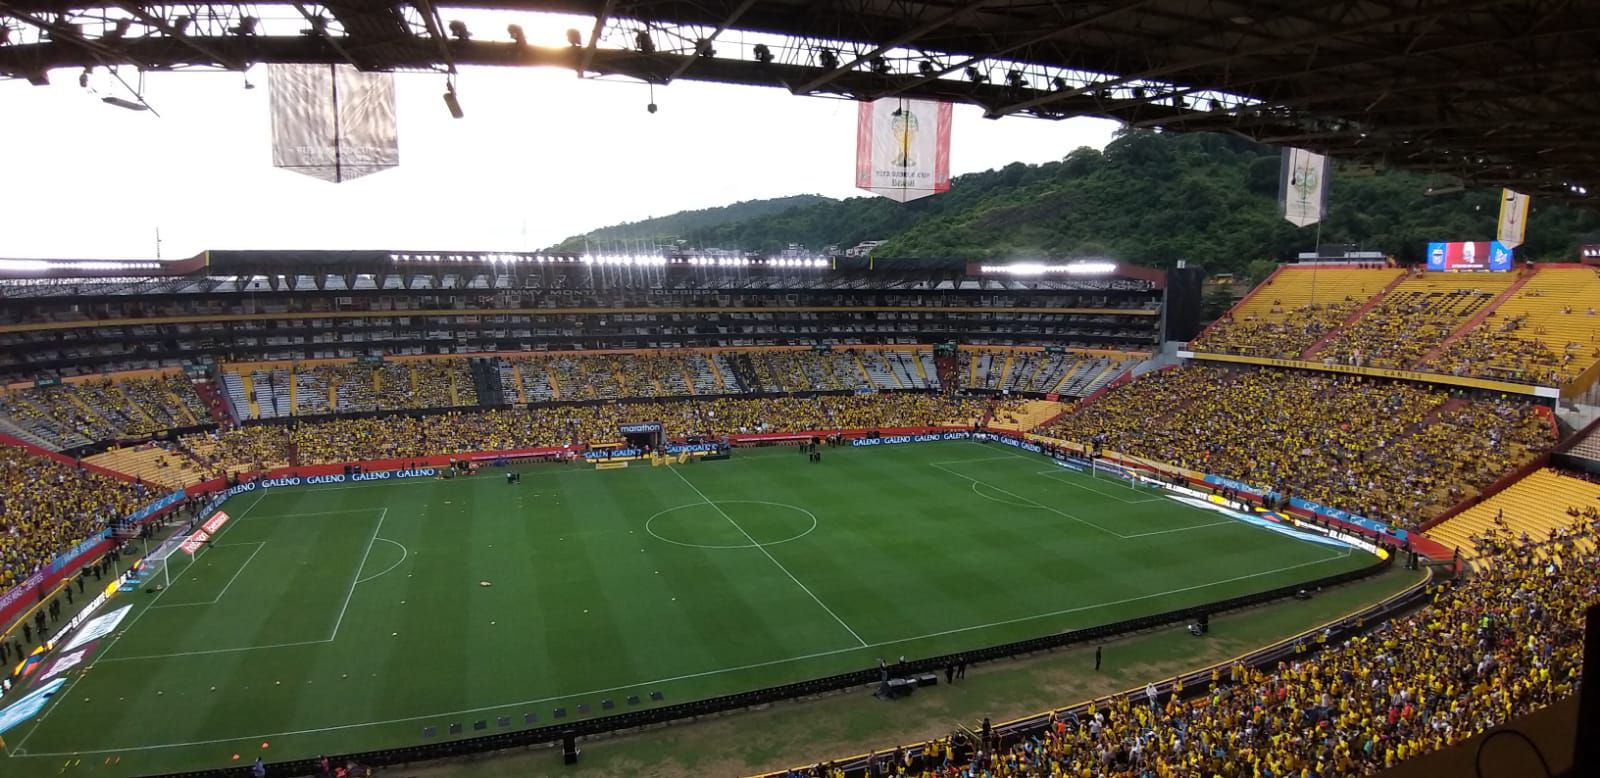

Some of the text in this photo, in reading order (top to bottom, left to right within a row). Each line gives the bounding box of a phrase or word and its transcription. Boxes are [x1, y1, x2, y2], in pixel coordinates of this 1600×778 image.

[620, 424, 660, 433] marathon
[853, 438, 880, 446] GALENO
[883, 436, 911, 444] GALENO
[914, 434, 940, 442] GALENO
[1021, 441, 1041, 453] GALENO
[261, 477, 301, 488] GALENO
[306, 474, 346, 484] GALENO
[352, 471, 390, 481] GALENO
[396, 468, 435, 478] GALENO
